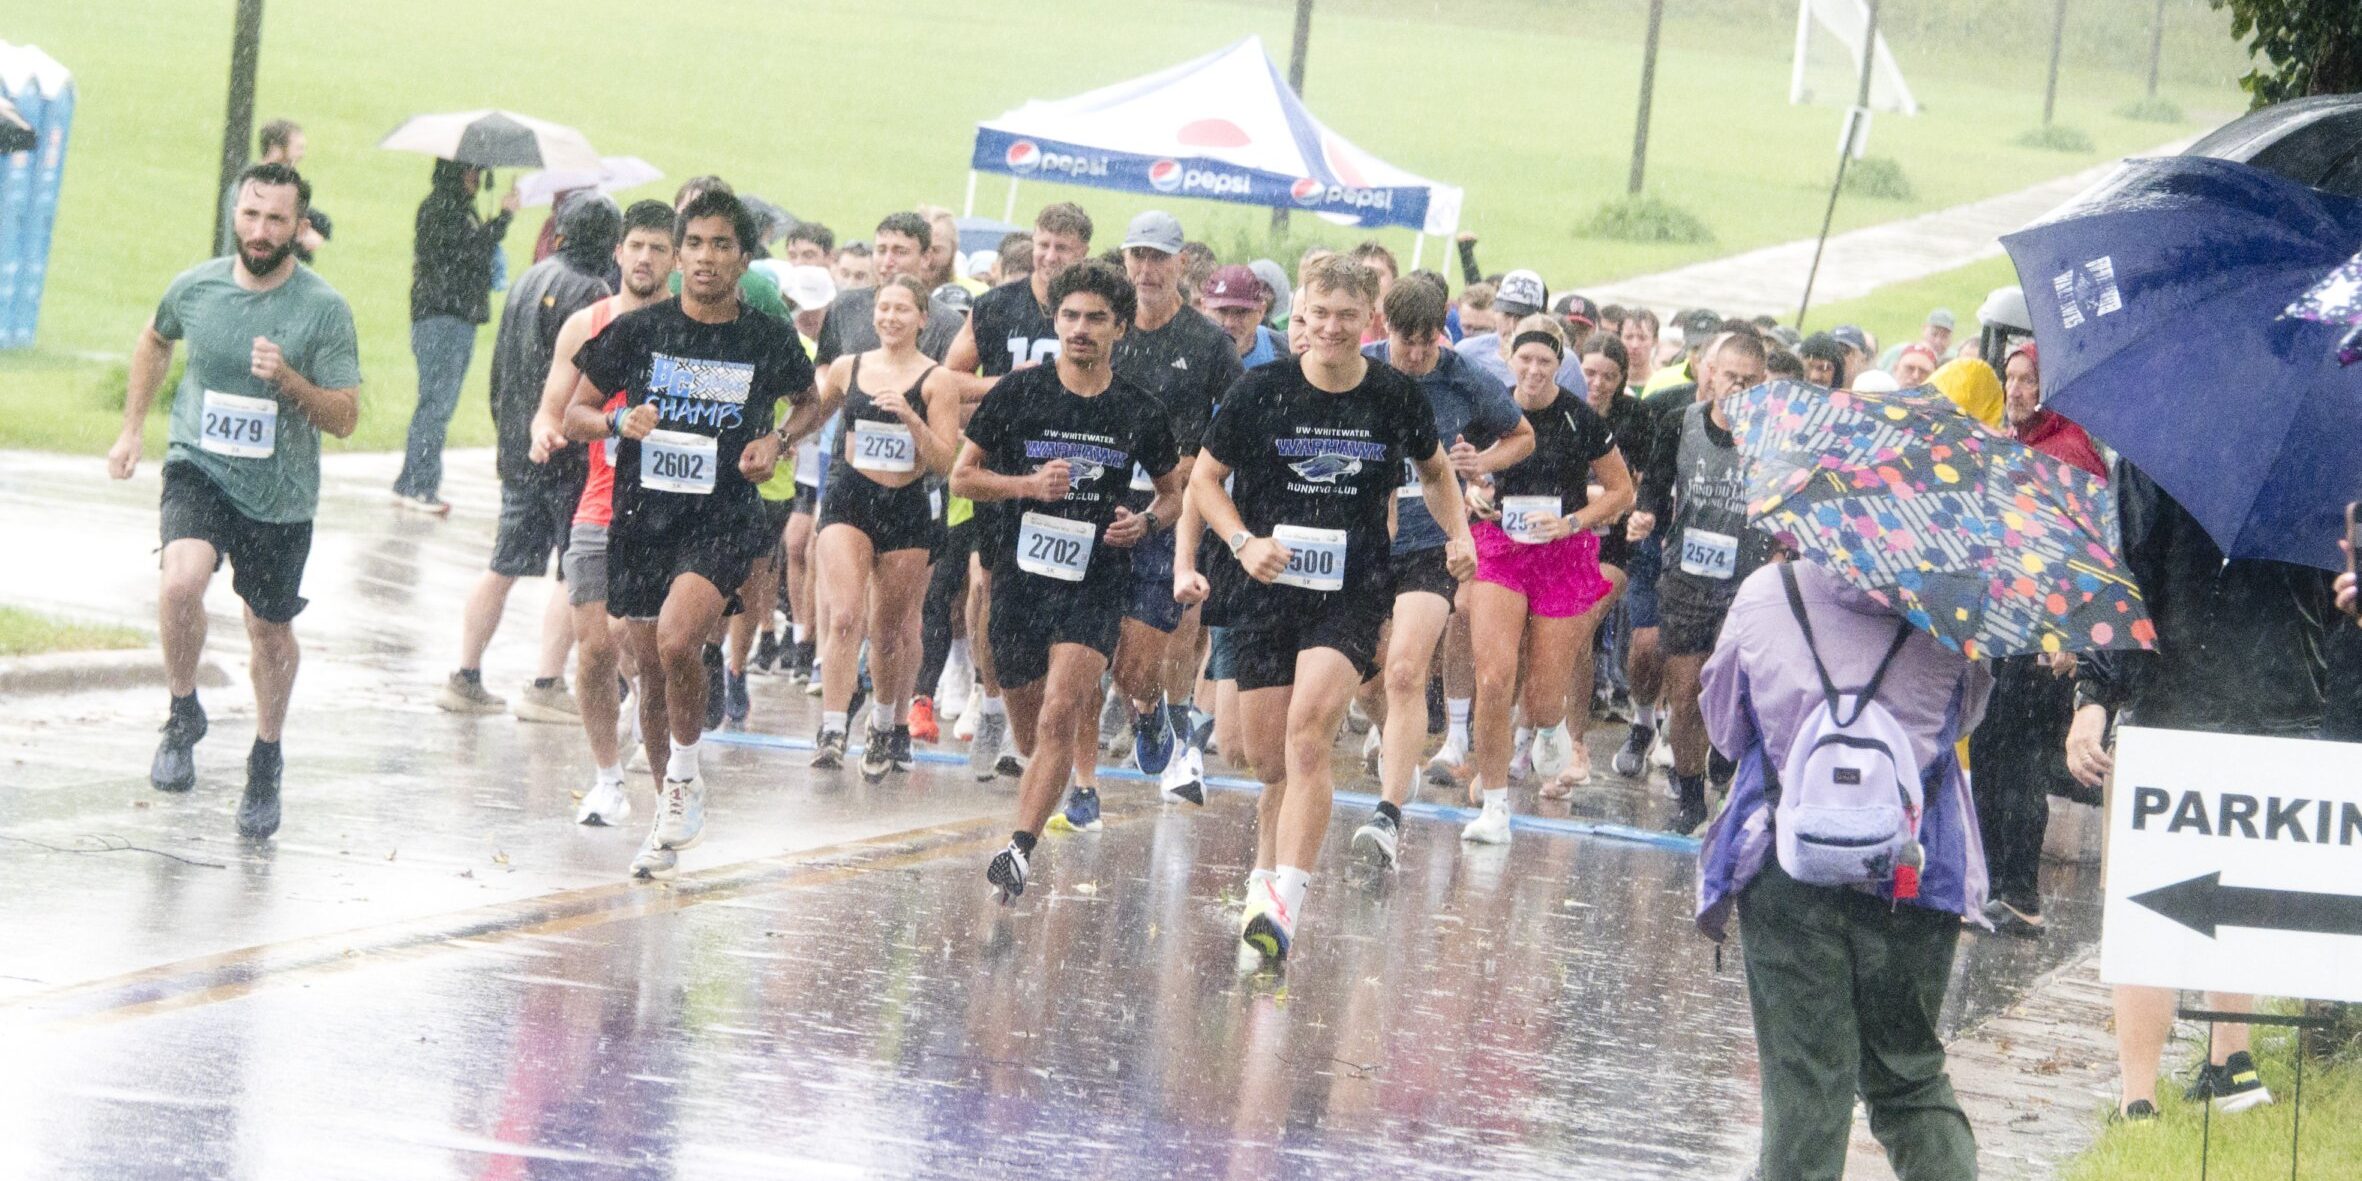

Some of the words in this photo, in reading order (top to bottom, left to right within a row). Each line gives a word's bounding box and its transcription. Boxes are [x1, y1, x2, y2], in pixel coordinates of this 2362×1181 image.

[1040, 151, 1109, 176] pepsi
[1182, 167, 1251, 195] pepsi
[1324, 184, 1393, 209] pepsi
[205, 412, 263, 443] 2479
[864, 435, 906, 460] 2752
[1024, 440, 1129, 469] WARHAWK
[1275, 437, 1387, 461] WARHAWK
[652, 450, 704, 480] 2602
[1286, 481, 1331, 494] RUNNING
[1028, 533, 1081, 567] 2702
[1285, 548, 1334, 575] 500
[1686, 542, 1726, 568] 2574
